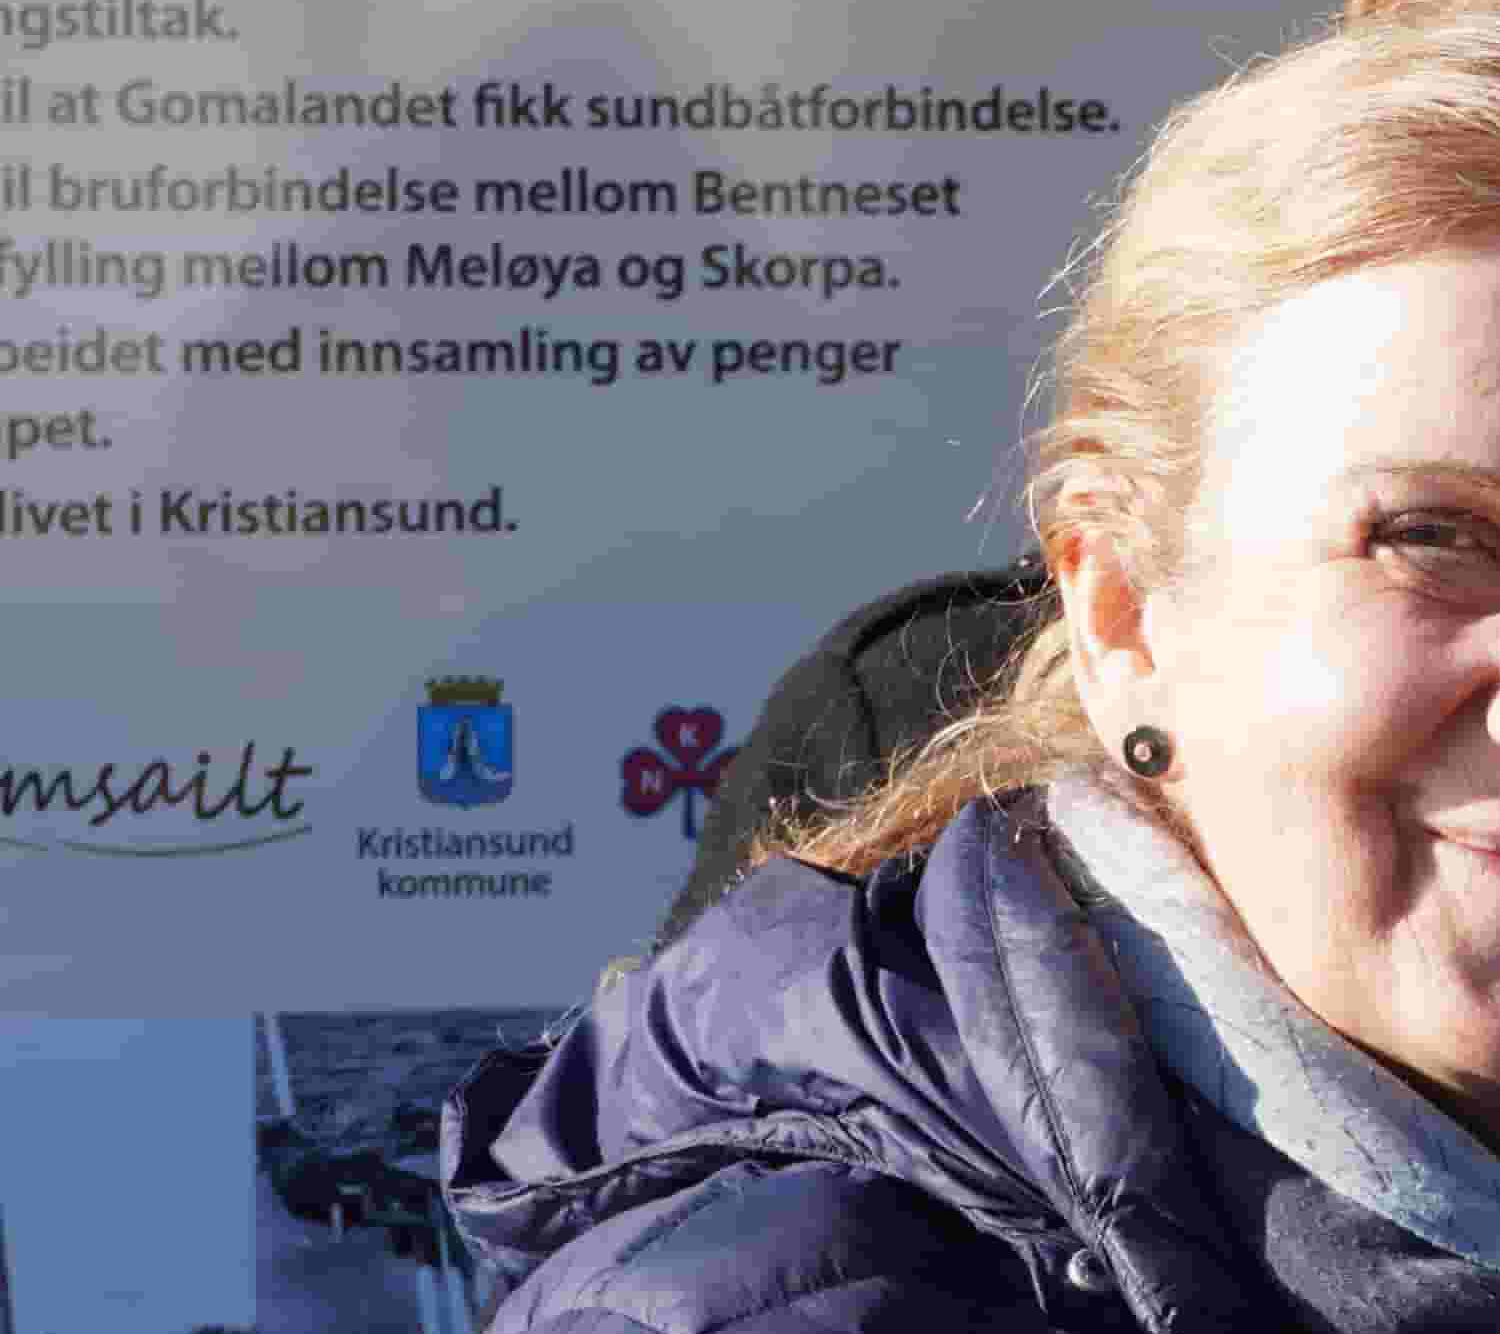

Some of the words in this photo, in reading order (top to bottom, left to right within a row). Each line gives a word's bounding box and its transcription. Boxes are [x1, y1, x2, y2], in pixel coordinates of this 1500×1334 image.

[48, 83, 99, 123] at
[117, 80, 458, 128] Gomalandet
[472, 79, 573, 131] fikk
[586, 83, 1120, 134] sundbåtforbindelse.
[48, 163, 460, 213] bruforbindelse
[475, 166, 677, 216] mellom
[694, 171, 960, 217] Bentneset
[184, 243, 389, 290] mellom
[406, 243, 601, 301] Meløya
[617, 253, 685, 302] og
[701, 243, 900, 299] Skorpa.
[184, 326, 301, 375] med
[320, 325, 622, 387] innsamling
[634, 339, 698, 375] av
[712, 339, 902, 387] penger
[131, 491, 141, 535] i
[160, 483, 520, 535] Kristiansund.
[357, 824, 574, 859] Kristiansund
[377, 867, 552, 899] kommune
